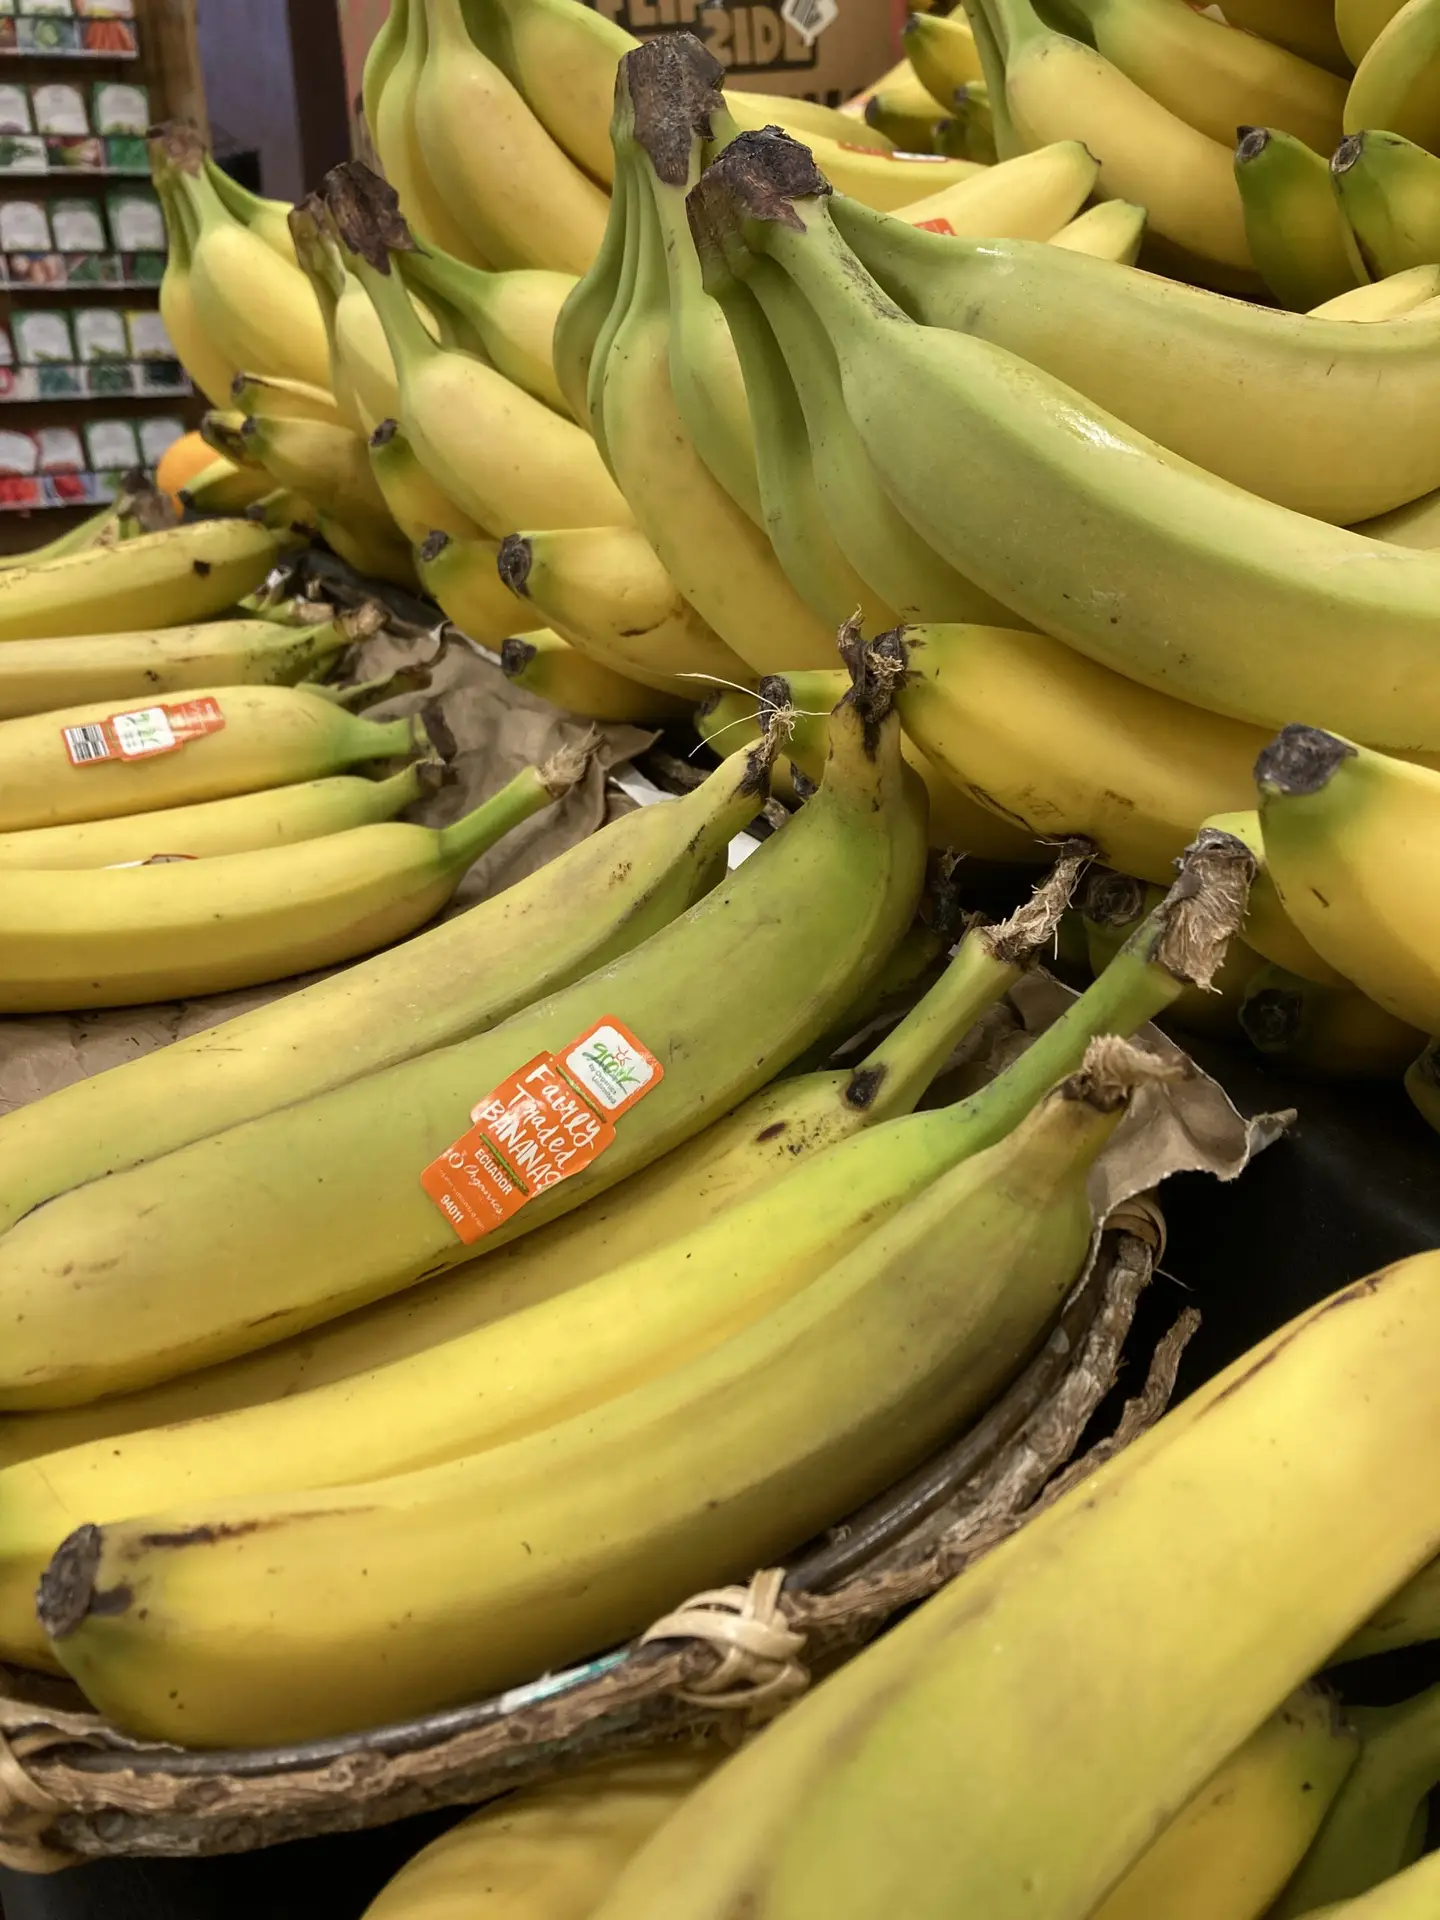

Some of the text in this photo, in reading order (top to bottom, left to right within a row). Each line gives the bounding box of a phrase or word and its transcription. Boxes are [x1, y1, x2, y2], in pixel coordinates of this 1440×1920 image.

[591, 1075, 616, 1105] Unlimited
[594, 1069, 617, 1095] Organics
[507, 1082, 578, 1170] Traded
[525, 1063, 601, 1150] Fairly
[474, 1148, 513, 1196] ECUADOR
[440, 1194, 464, 1224] 94011
